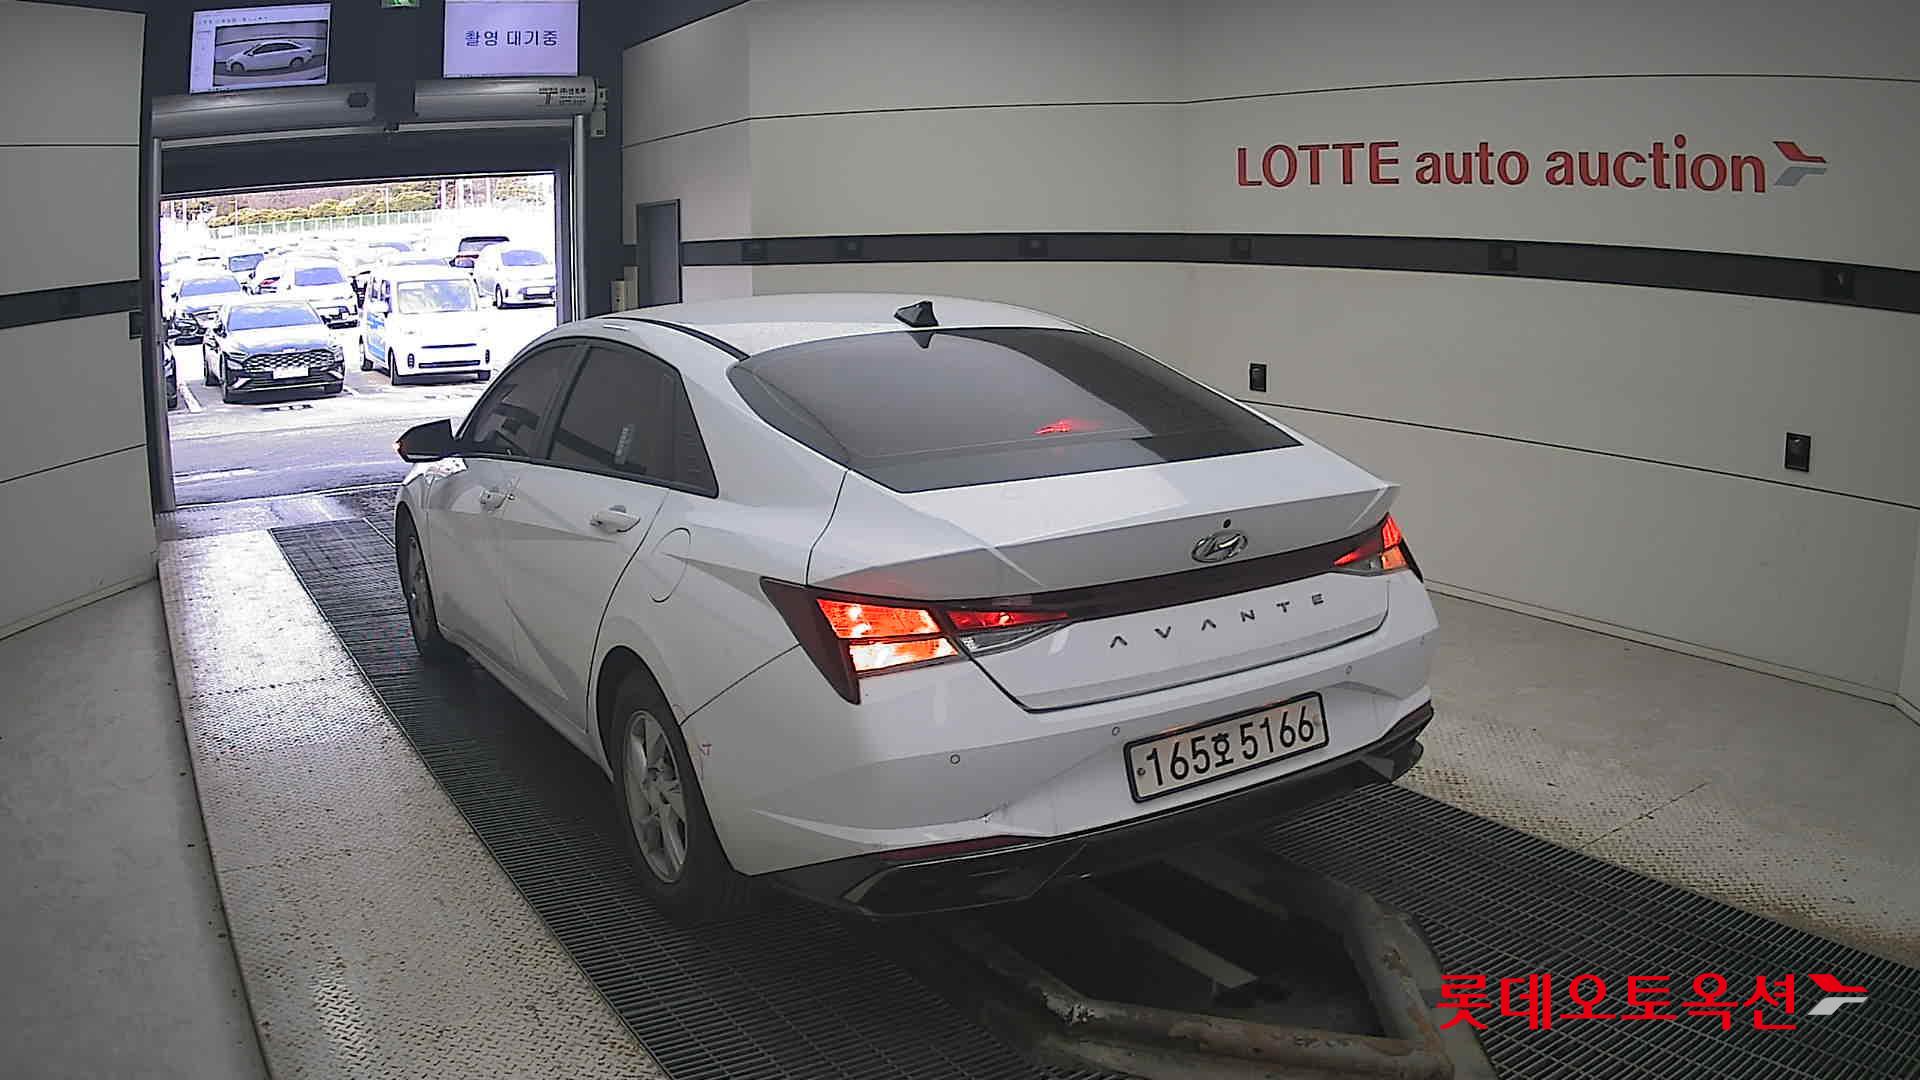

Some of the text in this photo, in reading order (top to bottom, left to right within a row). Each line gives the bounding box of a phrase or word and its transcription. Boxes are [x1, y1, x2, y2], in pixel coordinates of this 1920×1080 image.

[464, 30, 558, 47] 촬영 대기중
[1236, 134, 1766, 193] LOTTE auto auction
[1110, 593, 1325, 649] AVANTE
[1239, 705, 1315, 760] 5166
